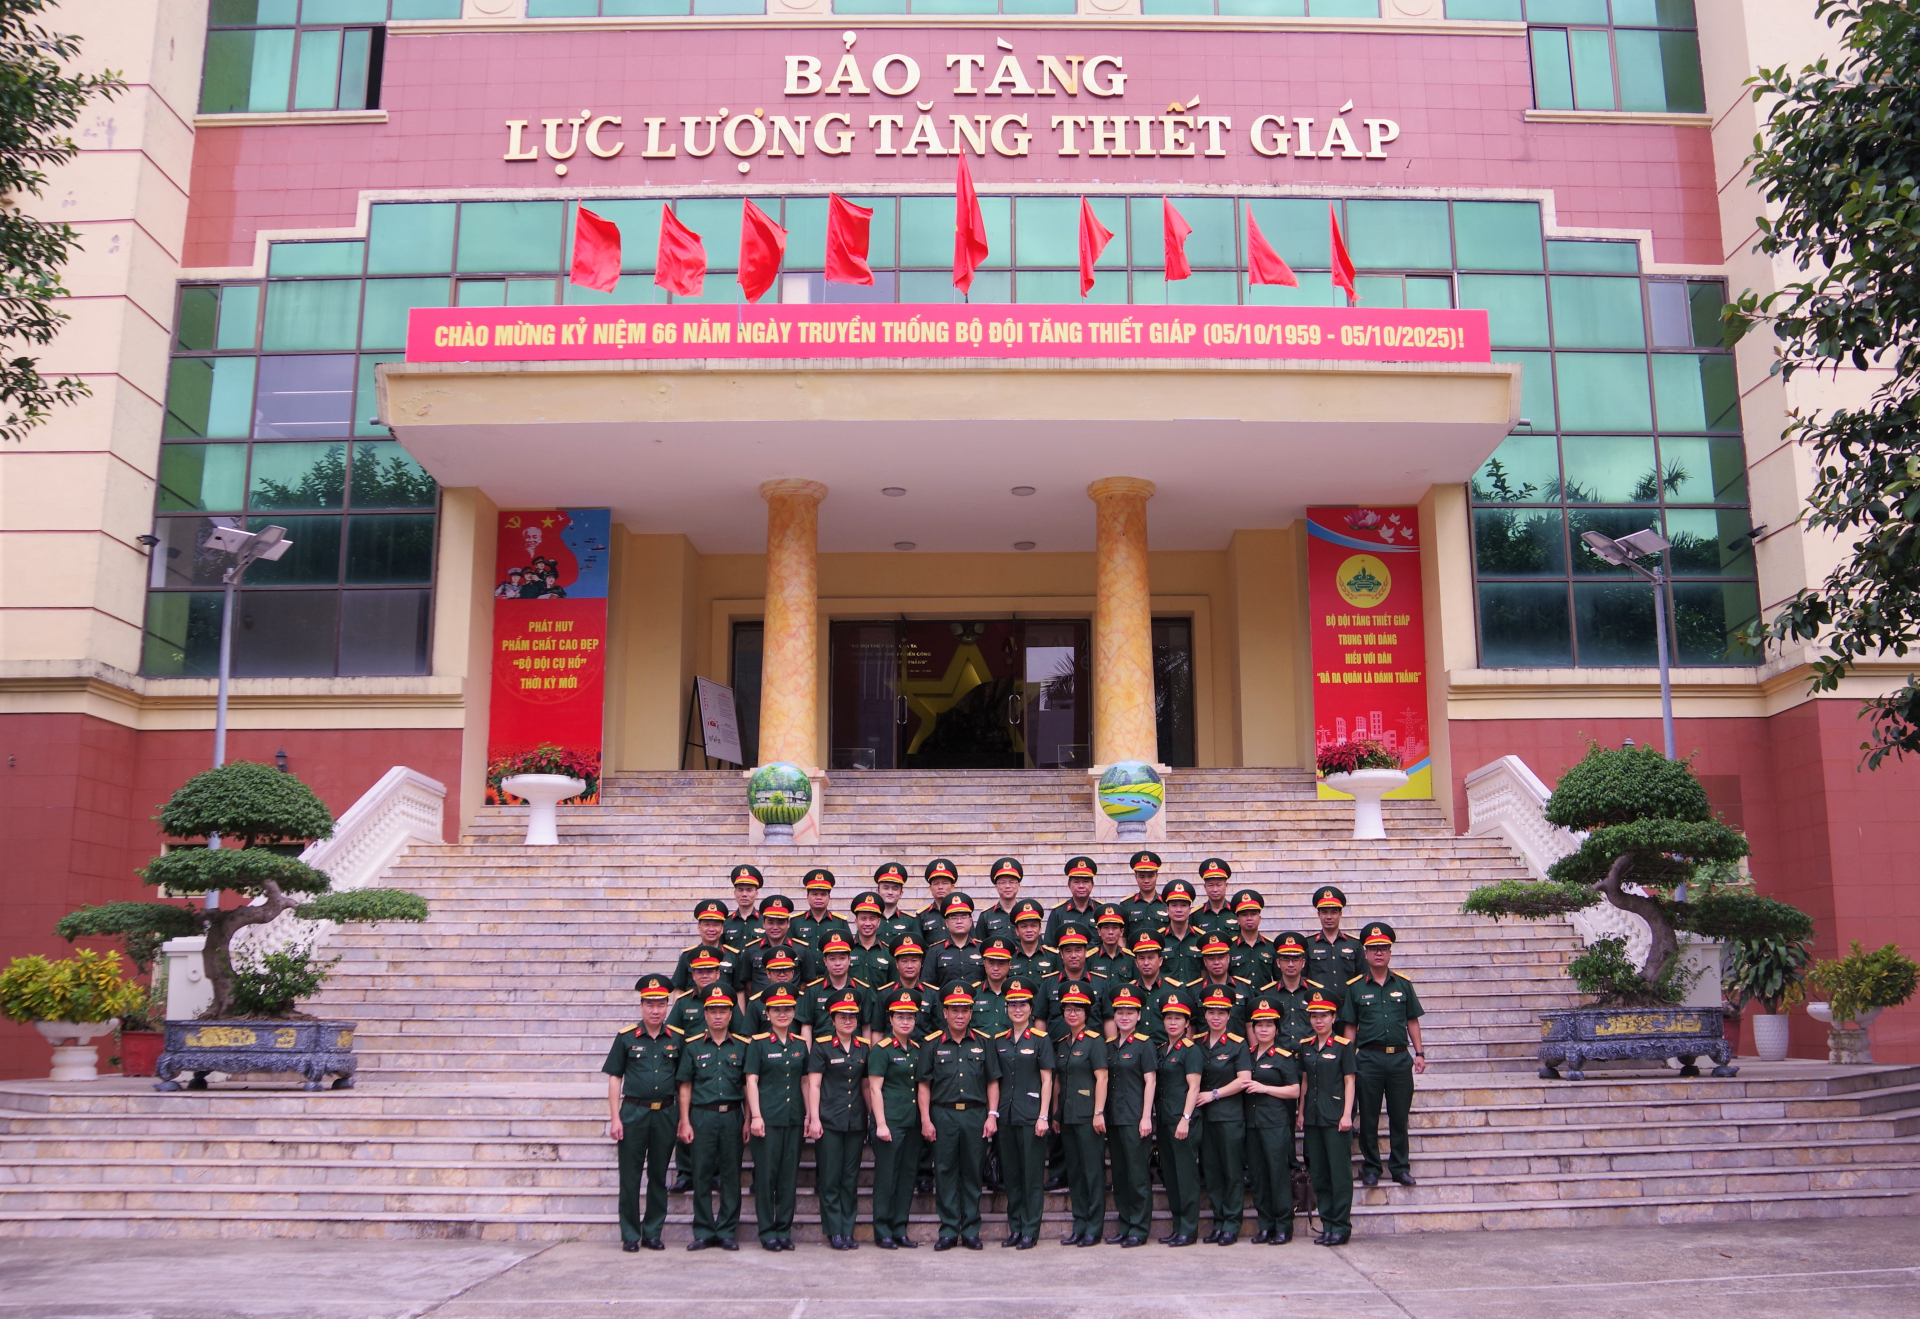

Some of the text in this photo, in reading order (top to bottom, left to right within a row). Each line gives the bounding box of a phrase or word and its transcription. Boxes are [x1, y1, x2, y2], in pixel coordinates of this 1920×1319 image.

[783, 30, 1128, 97] BẢO TÀNG
[503, 94, 1400, 177] LỰC LƯỢNG TĂNG THIẾT GIÁP
[434, 321, 489, 347] CHÀO
[494, 321, 556, 346] MỪNG
[561, 317, 588, 345] KỶ
[593, 319, 646, 349] NIỆM
[652, 322, 677, 344] 66
[683, 318, 731, 343] NĂM
[737, 317, 792, 344] NGÀY
[797, 315, 876, 343] TRUYỀN
[882, 315, 949, 343] THỐNG
[956, 317, 982, 347] BỘ
[988, 318, 1023, 347] ĐỘI
[1029, 317, 1082, 343] TĂNG
[1088, 316, 1143, 343] THIẾT
[1149, 318, 1196, 344] GIÁP
[1203, 323, 1321, 346] (05/10/1959
[1341, 325, 1464, 350] 05/10/2025)!
[528, 619, 574, 633] PHÁT HUY
[1325, 612, 1410, 629] BỘ ĐỘI TĂNG THIẾT GIÁP
[502, 636, 599, 653] PHẨM CHẤT CAO ĐẸP
[1338, 632, 1397, 645] TRUNG VỚI ĐẢNG
[533, 656, 550, 672] ĐỘI
[552, 658, 566, 671] CỤ
[1345, 650, 1392, 665] HIẾU VỚI DÂN
[520, 675, 542, 689] THỜI
[558, 675, 578, 689] MỚI
[1332, 672, 1342, 684] RA
[1343, 671, 1362, 685] QUÂN
[1364, 670, 1372, 684] LÀ
[1374, 671, 1393, 684] ĐÁNH
